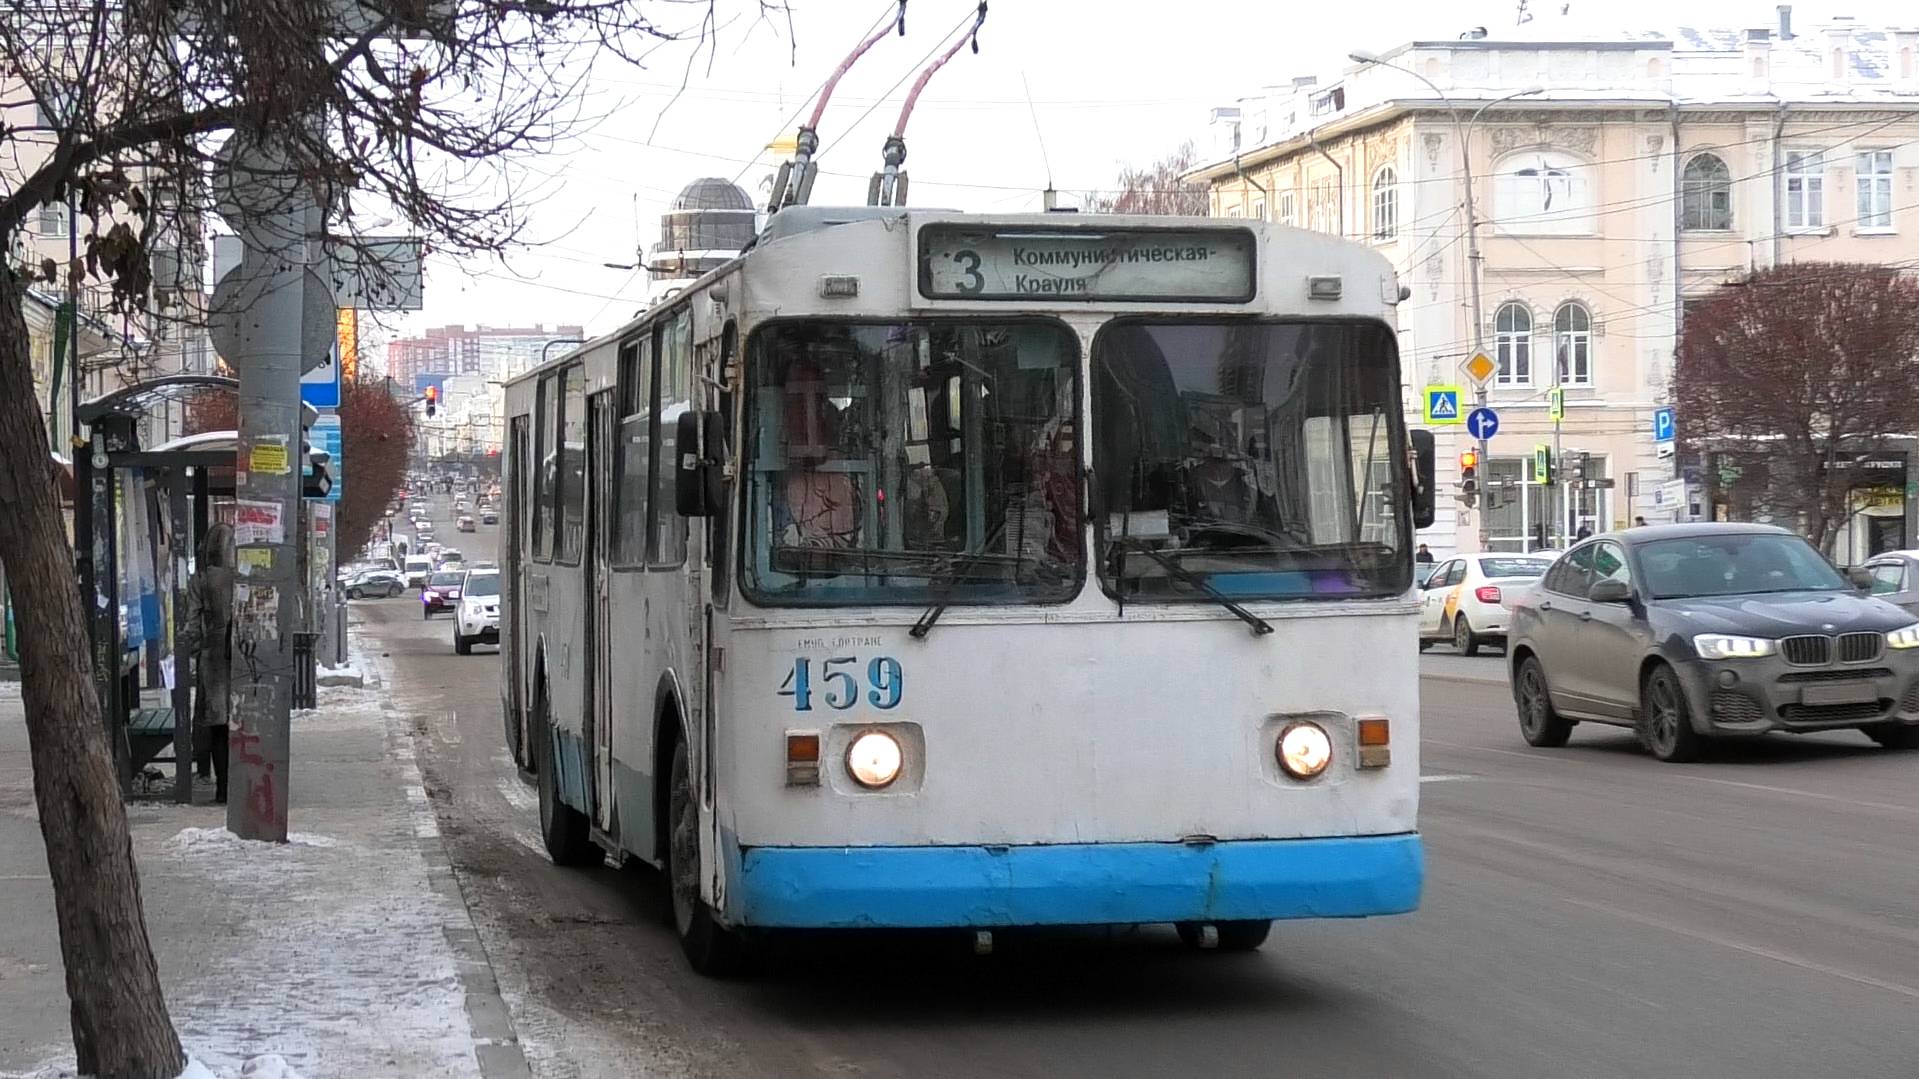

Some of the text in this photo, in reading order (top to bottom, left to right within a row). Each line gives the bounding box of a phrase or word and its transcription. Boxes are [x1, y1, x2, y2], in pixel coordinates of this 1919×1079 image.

[953, 249, 985, 294] 3
[1015, 274, 1088, 295] Крауля
[776, 656, 903, 711] 459
